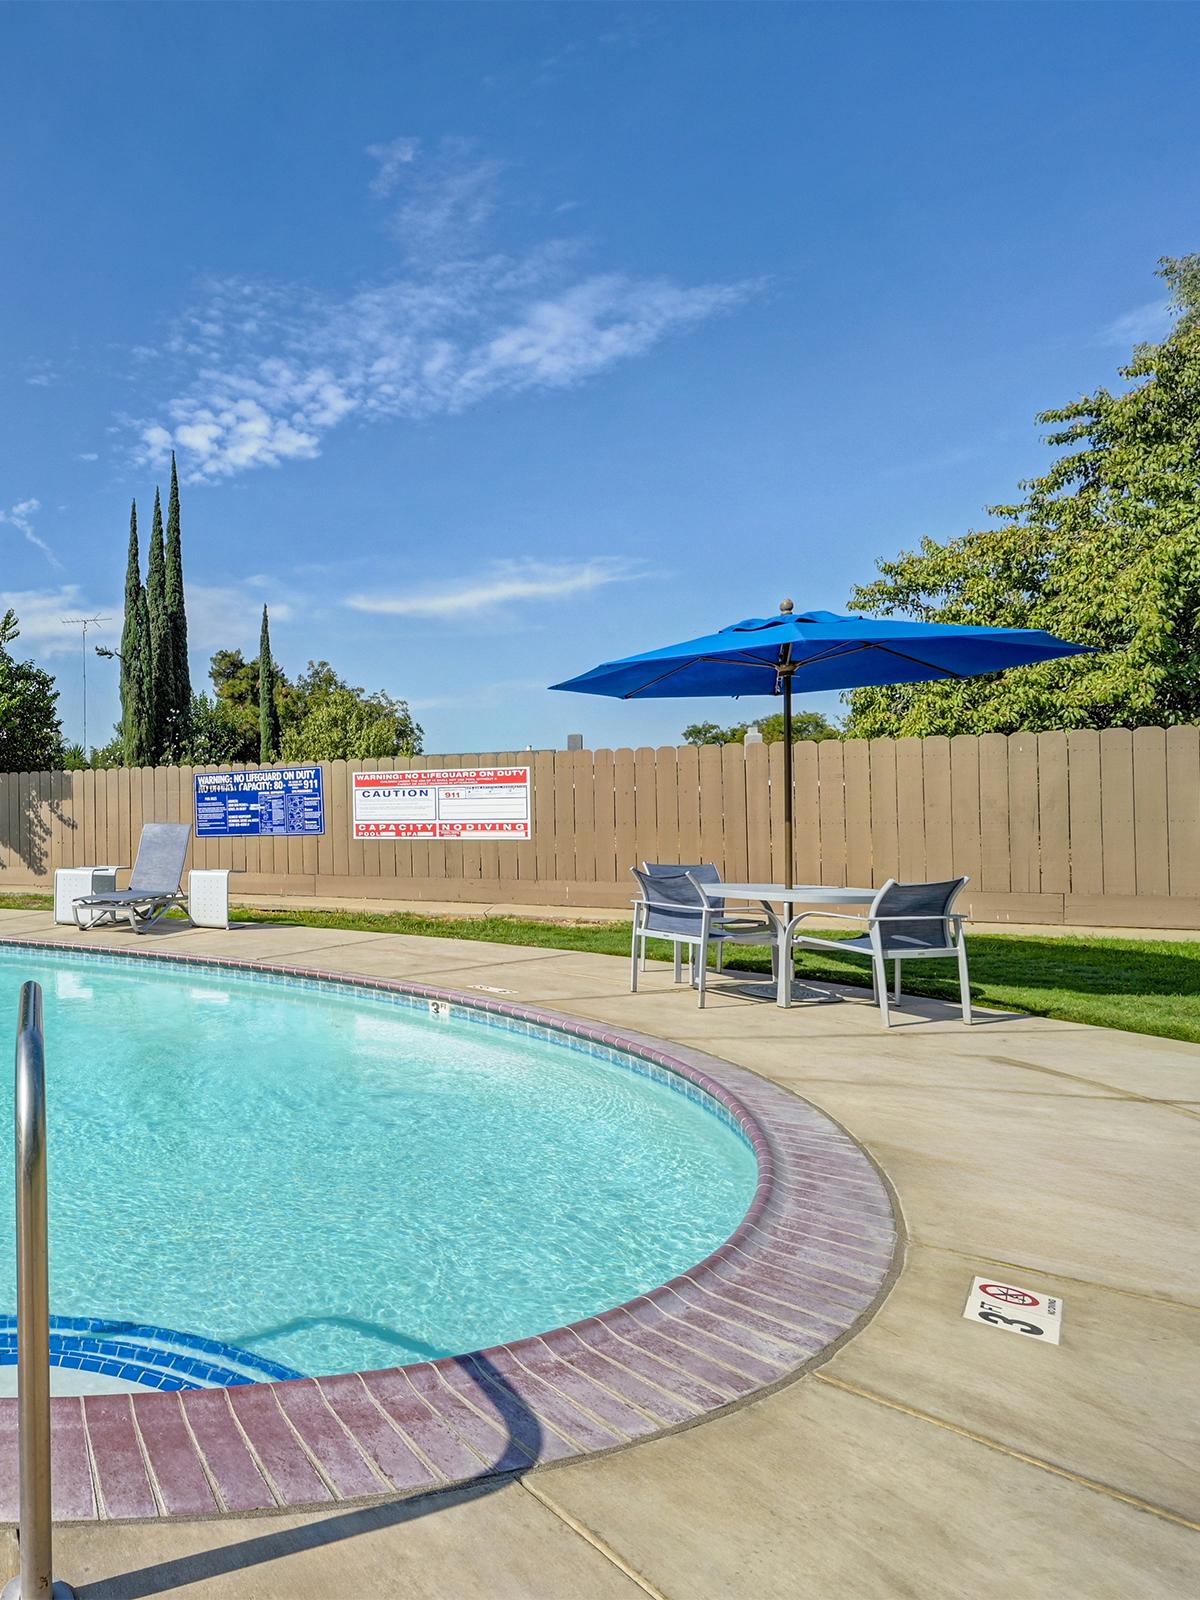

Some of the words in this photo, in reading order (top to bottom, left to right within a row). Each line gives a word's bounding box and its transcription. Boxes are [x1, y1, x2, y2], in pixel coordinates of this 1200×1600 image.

[198, 774, 232, 784] WARNING:
[234, 774, 244, 782] NO
[246, 772, 282, 782] LIFEGUARD
[283, 771, 294, 780] ON
[296, 770, 316, 779] DUTY
[238, 781, 272, 792] CAPACITY:
[304, 779, 318, 789] 911
[362, 789, 428, 798] CAUTION
[432, 1002, 440, 1014] 3
[978, 1311, 1044, 1336] 3
